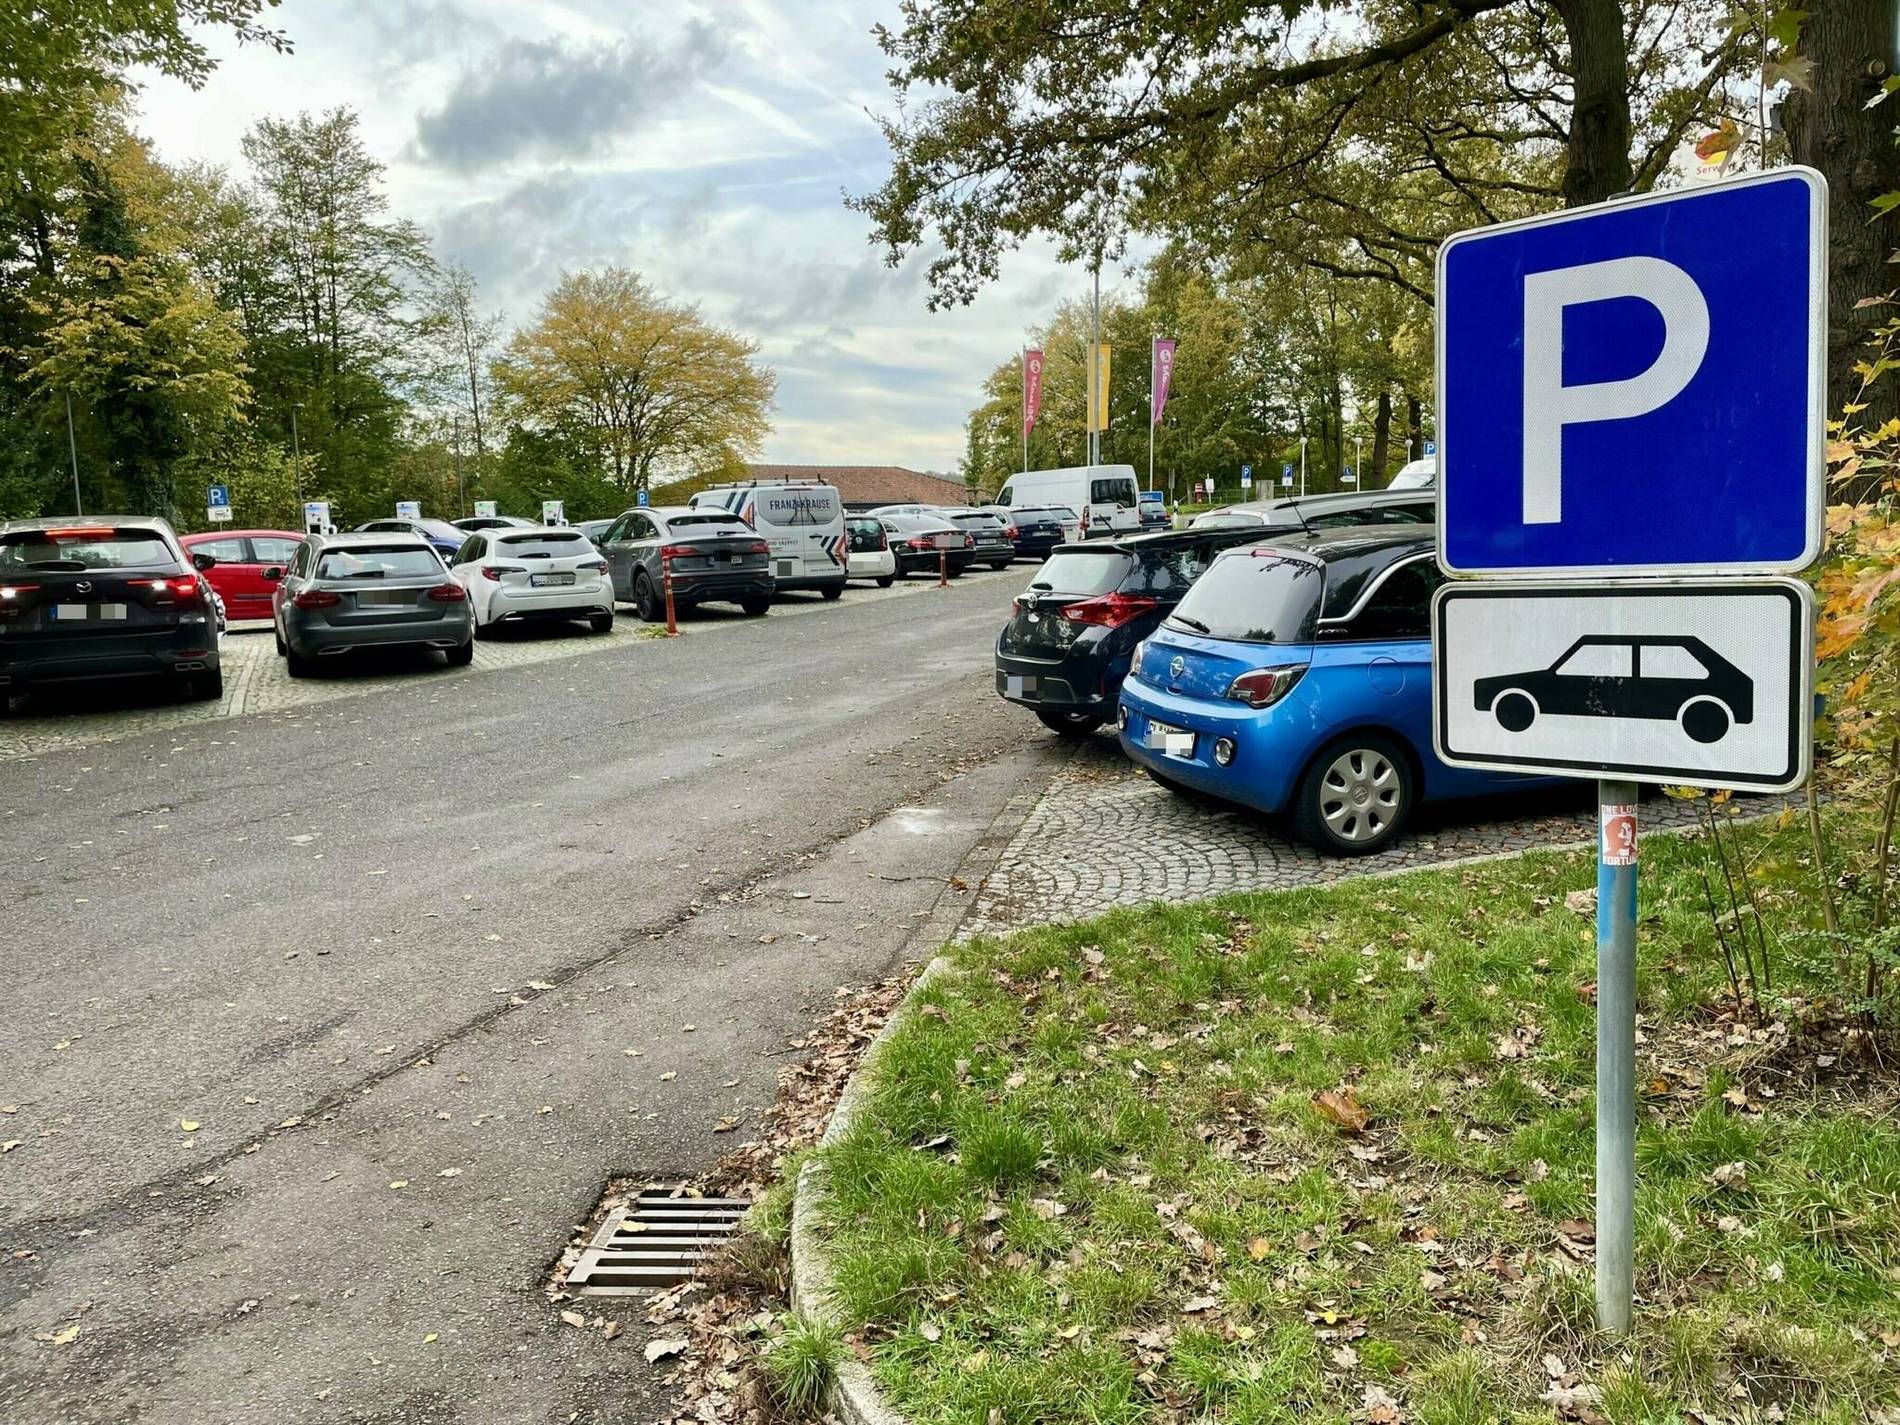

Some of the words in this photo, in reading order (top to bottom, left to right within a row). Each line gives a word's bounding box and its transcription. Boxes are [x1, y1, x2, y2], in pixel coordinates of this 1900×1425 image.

[1523, 256, 1710, 524] P
[1427, 443, 1434, 454] P
[210, 489, 221, 504] P
